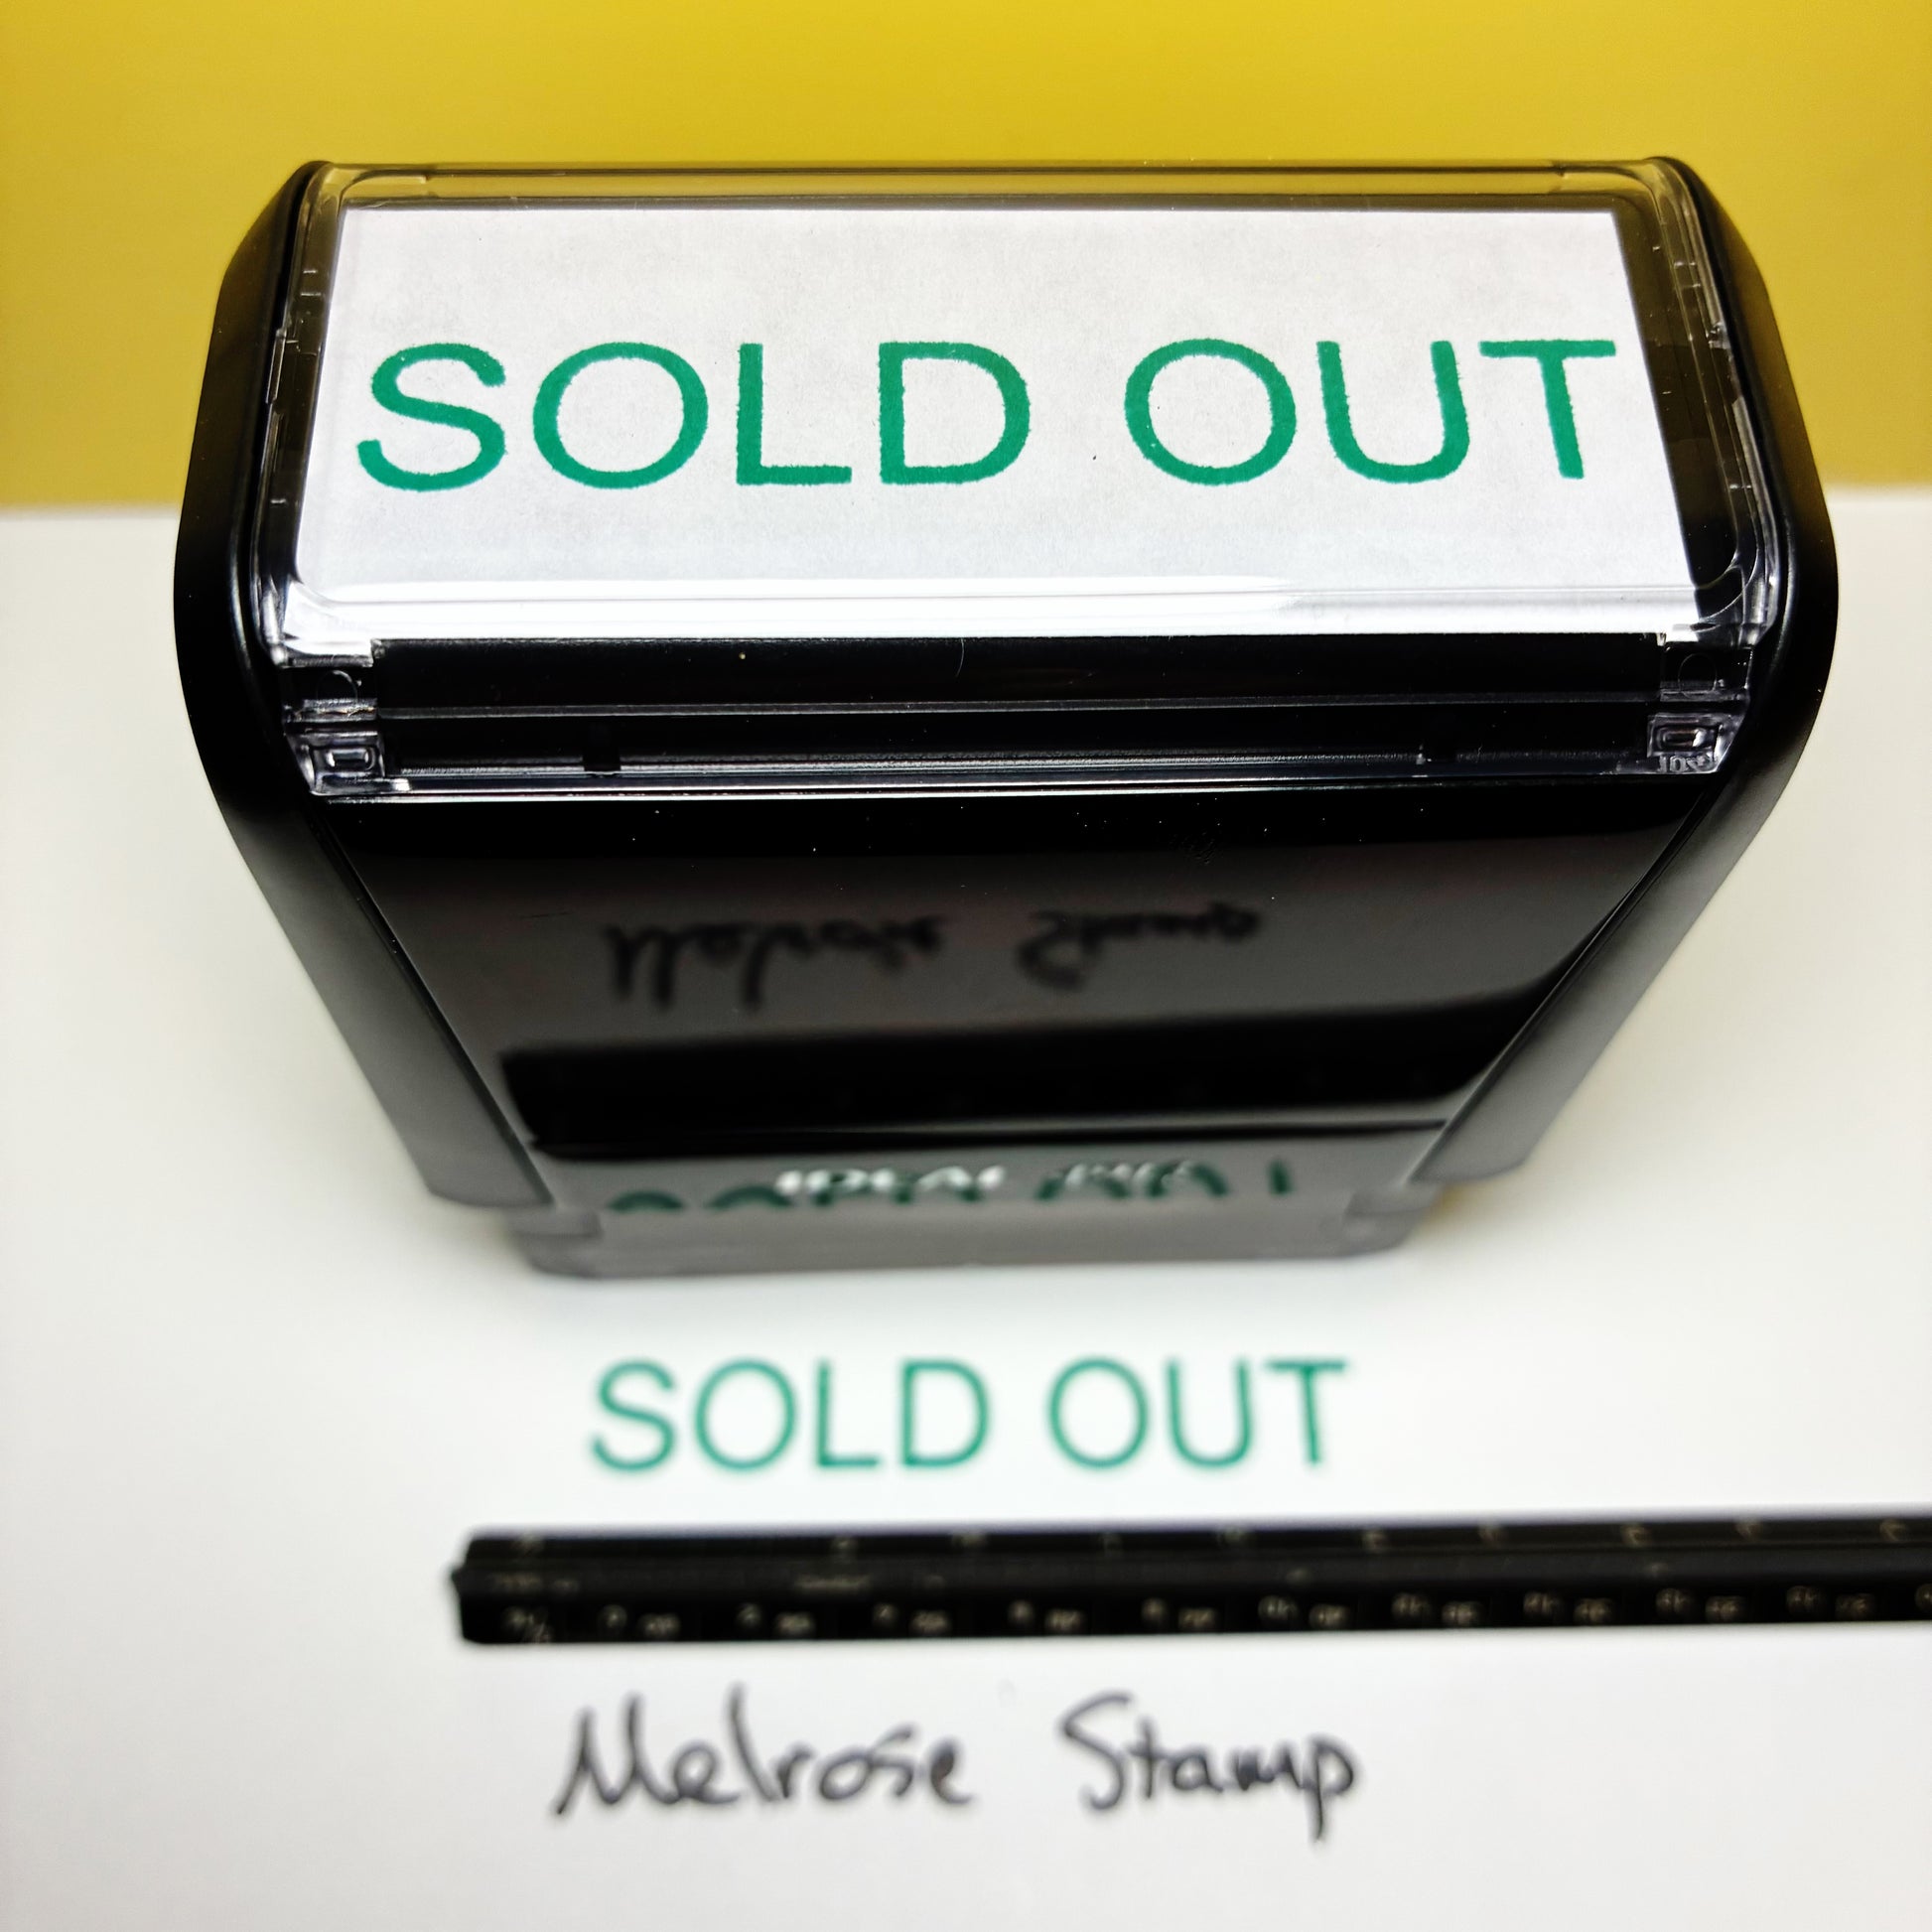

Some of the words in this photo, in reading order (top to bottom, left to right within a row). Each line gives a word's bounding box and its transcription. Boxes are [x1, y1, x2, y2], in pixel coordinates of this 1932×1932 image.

[356, 341, 1031, 493] SOLD
[1124, 338, 1616, 486] OUT
[590, 1358, 991, 1473] SOLD
[1046, 1356, 1352, 1470] OUT
[552, 1682, 973, 1818] Melrose
[1058, 1691, 1358, 1842] Stamp
